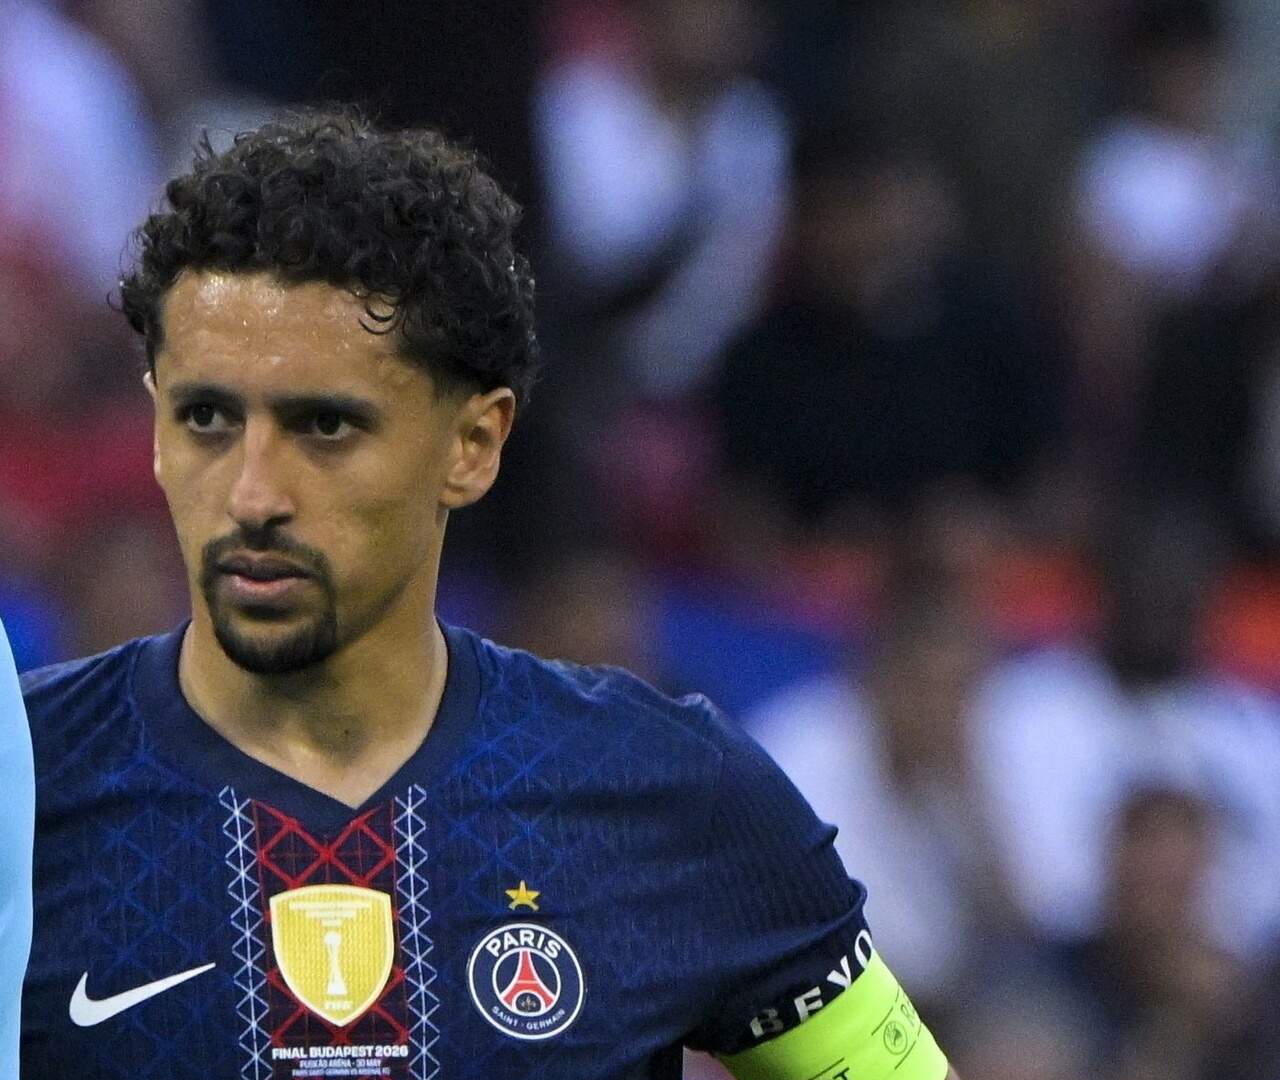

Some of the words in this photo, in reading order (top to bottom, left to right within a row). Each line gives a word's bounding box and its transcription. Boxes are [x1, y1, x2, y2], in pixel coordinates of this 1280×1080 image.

[485, 929, 561, 958] PARIS
[271, 1047, 308, 1060] FINAL
[309, 1045, 374, 1059] BUDAPEST
[374, 1045, 409, 1058] 2026
